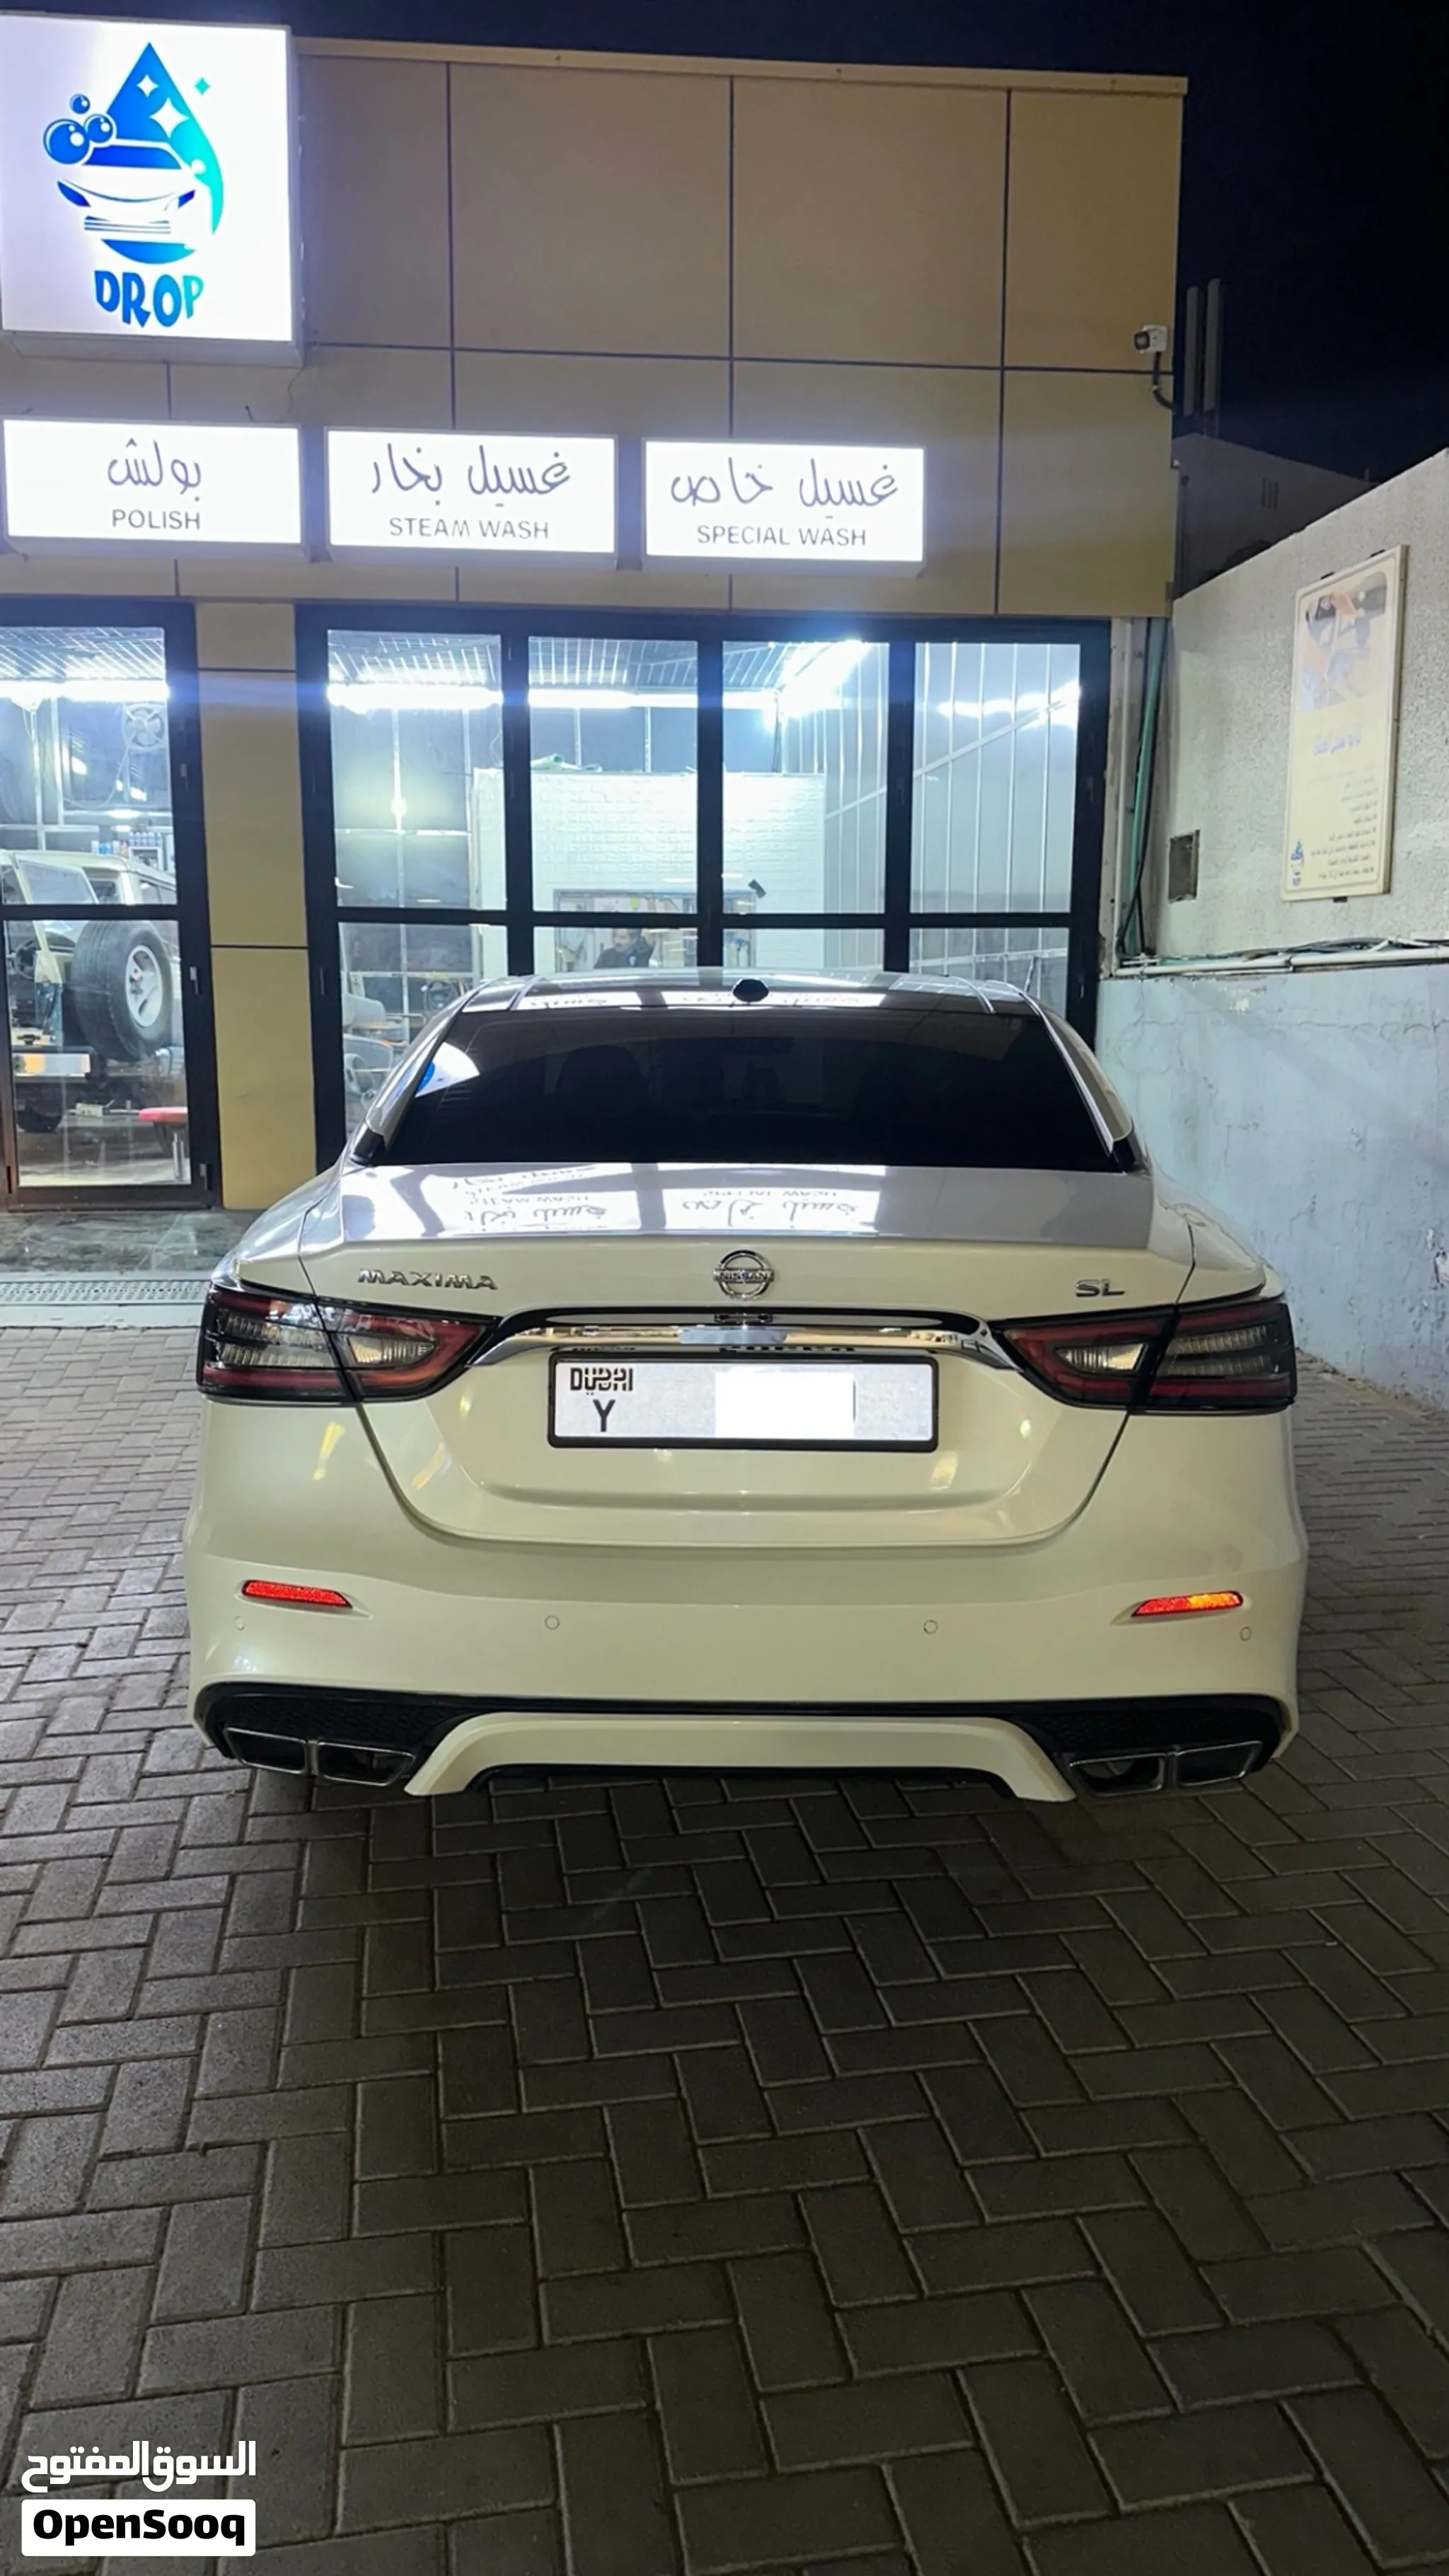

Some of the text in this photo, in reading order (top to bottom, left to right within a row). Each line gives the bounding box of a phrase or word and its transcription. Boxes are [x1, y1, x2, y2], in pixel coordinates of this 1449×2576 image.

[94, 270, 204, 328] DROP
[108, 438, 202, 502] بولش
[372, 442, 571, 508] غسيل بخار
[671, 456, 898, 519] غسيل خاص
[112, 509, 201, 530] POLISH
[389, 517, 549, 539] STEAM WASH
[698, 525, 867, 546] SPECIAL WASH
[357, 1269, 498, 1290] MAXIMA
[720, 1271, 767, 1281] NISSAN
[1075, 1278, 1126, 1298] SL
[593, 1399, 616, 1432] Y
